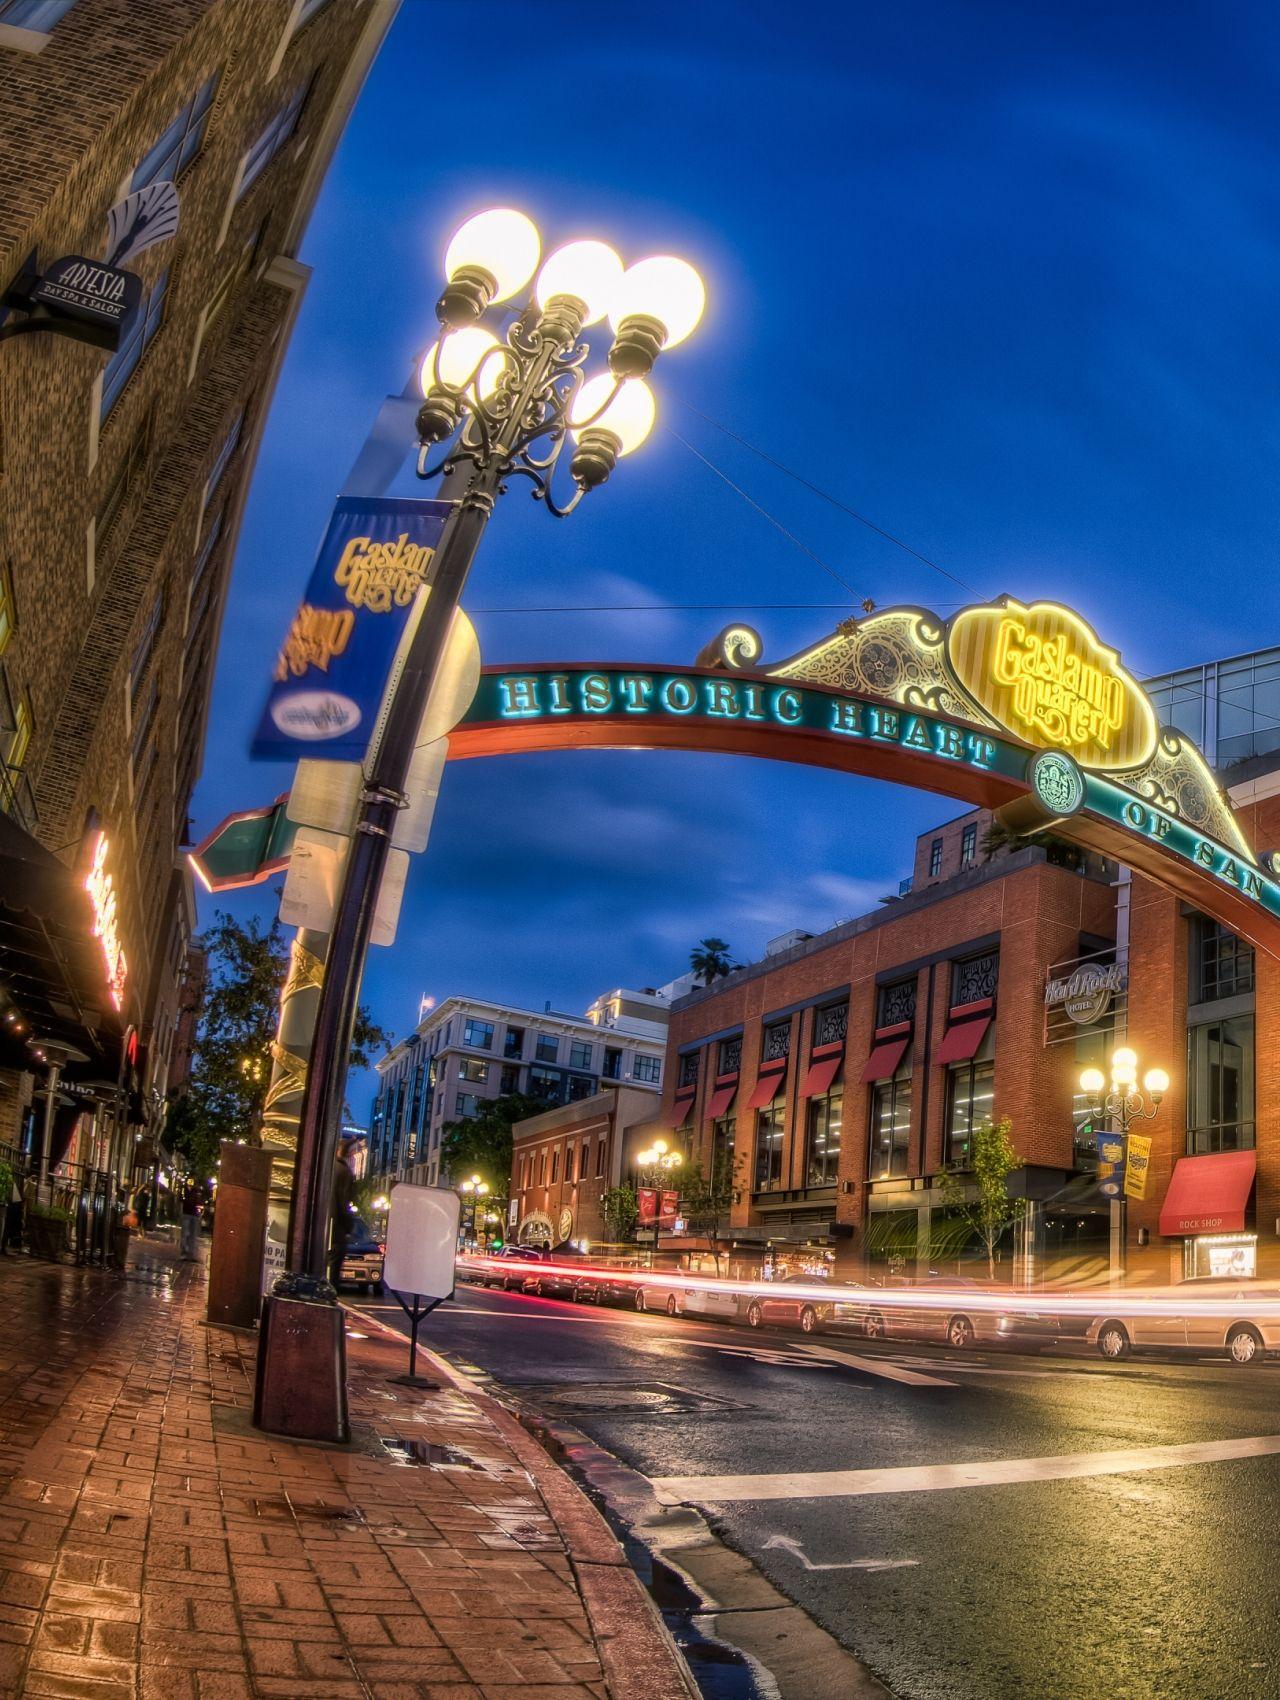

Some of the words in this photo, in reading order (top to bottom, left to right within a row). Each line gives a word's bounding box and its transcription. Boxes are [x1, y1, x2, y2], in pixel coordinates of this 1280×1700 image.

[43, 284, 62, 297] DAY
[61, 289, 80, 303] SPA
[80, 297, 88, 306] &
[88, 298, 121, 315] SALON
[58, 262, 125, 302] ARTESIA
[334, 533, 435, 586] Gaslam
[993, 618, 1125, 740] Gaslamp
[1014, 673, 1105, 747] Quarter
[500, 675, 802, 724] HISTORIC
[832, 700, 997, 768] HEART
[1123, 801, 1171, 841] OF
[1195, 841, 1265, 902] SAN
[1045, 974, 1080, 1006] Hard
[1080, 965, 1122, 998] Rock
[1069, 1001, 1093, 1013] HOTEL
[1180, 1220, 1201, 1229] ROCK
[1201, 1218, 1223, 1228] SHOP
